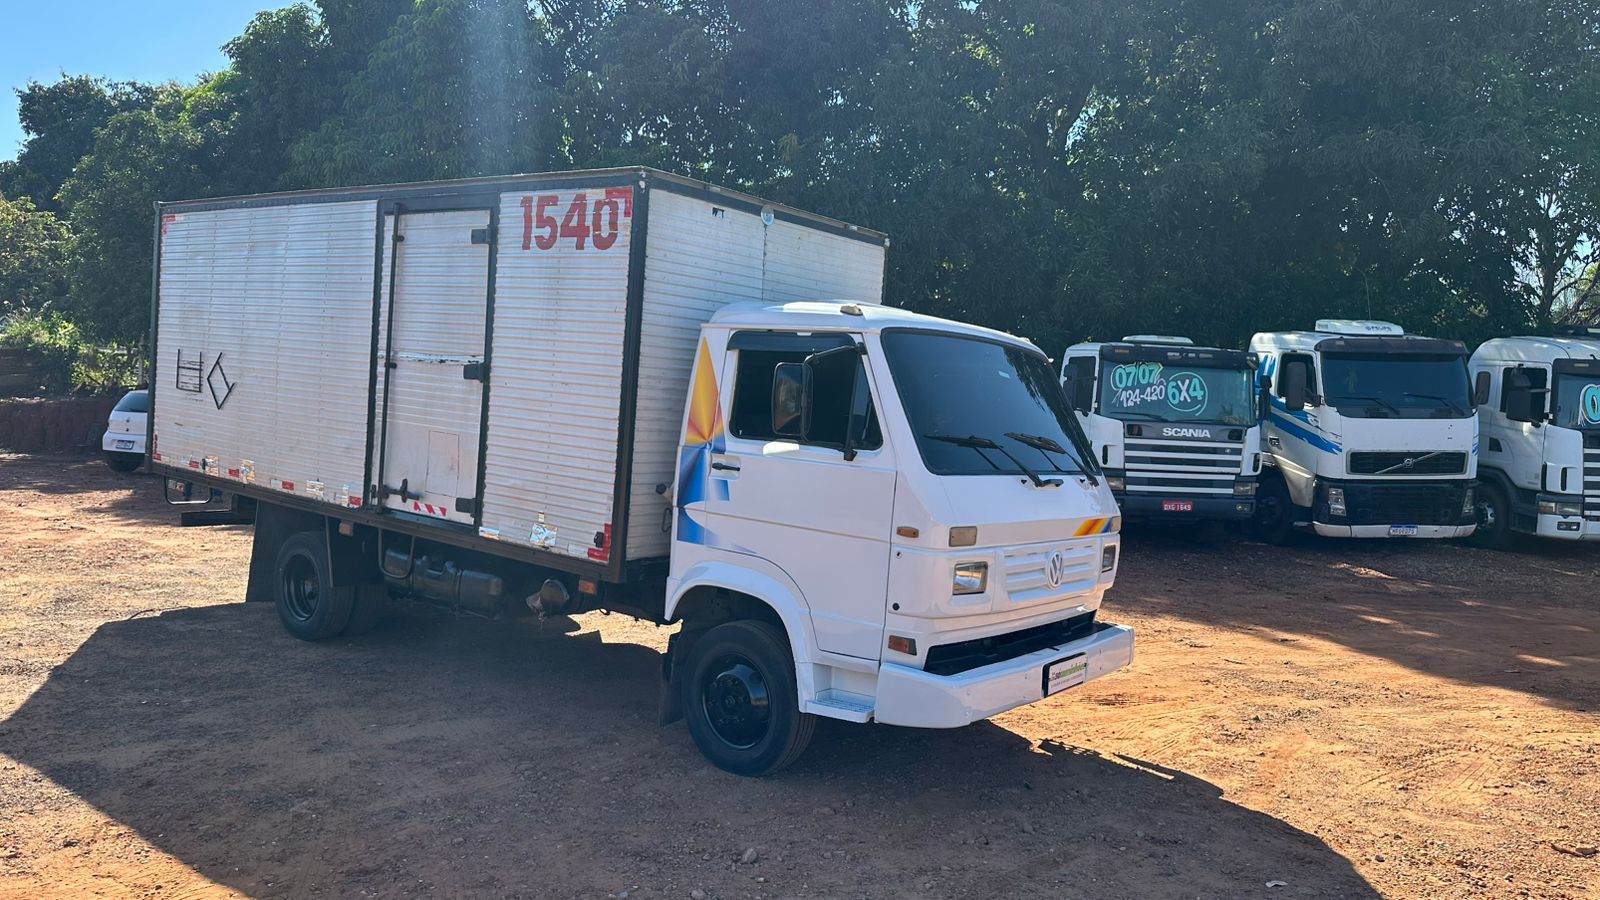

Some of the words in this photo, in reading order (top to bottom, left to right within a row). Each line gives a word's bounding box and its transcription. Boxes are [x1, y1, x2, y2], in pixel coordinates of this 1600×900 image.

[520, 193, 619, 250] 1540
[1115, 362, 1160, 388] 07/07
[1120, 384, 1165, 407] 124-420
[1167, 376, 1204, 405] 6X4
[1162, 427, 1211, 438] SCANIA
